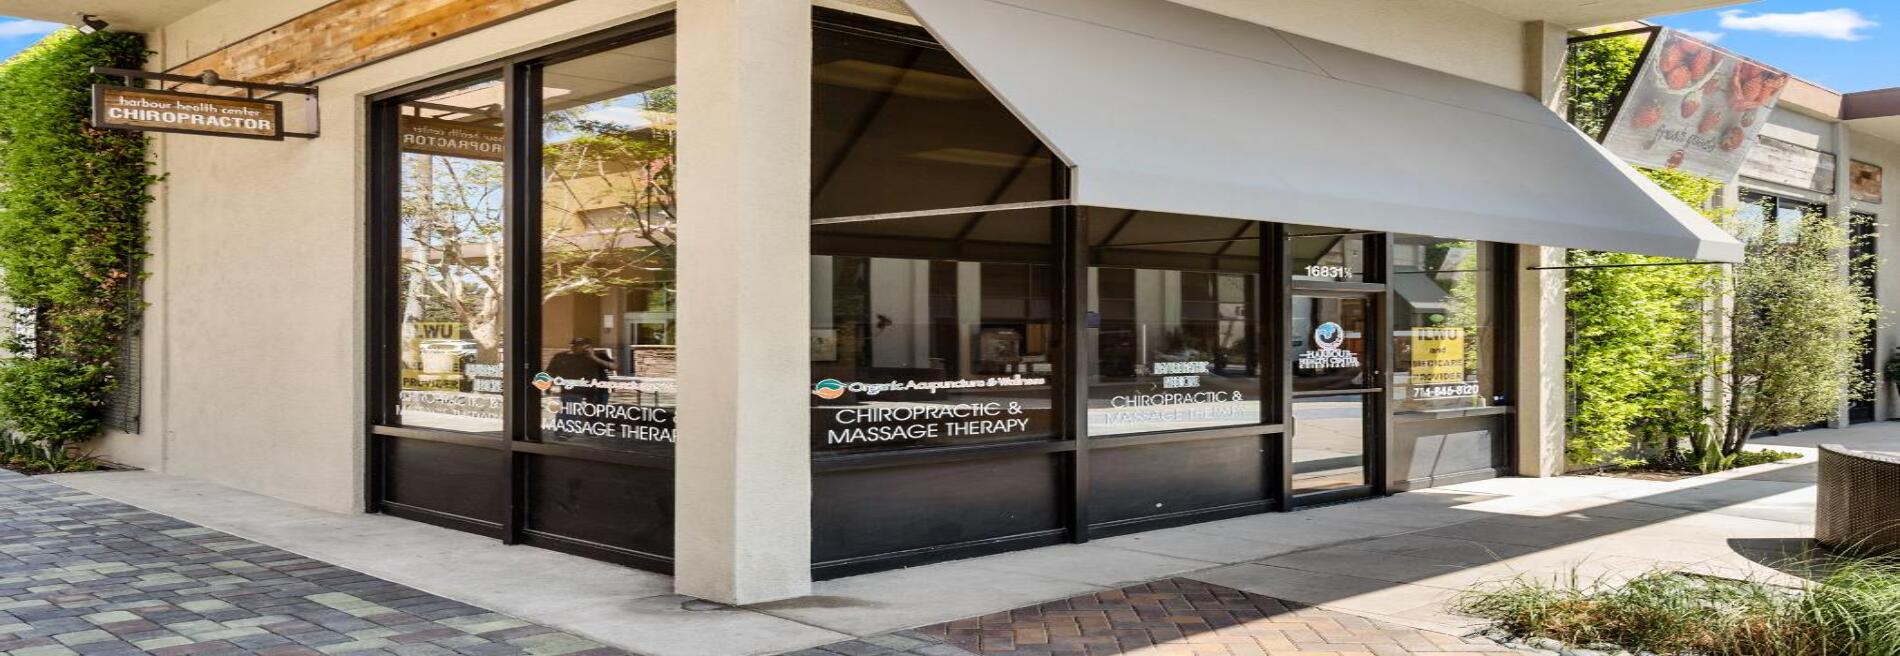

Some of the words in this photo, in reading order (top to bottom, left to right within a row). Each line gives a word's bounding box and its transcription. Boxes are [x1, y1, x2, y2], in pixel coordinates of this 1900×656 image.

[118, 96, 171, 111] harbour
[176, 101, 218, 113] health
[221, 107, 261, 118] center
[109, 107, 272, 130] CHIROPRACTOR
[1412, 360, 1464, 368] MEDICARE
[553, 376, 590, 390] Organic
[848, 380, 902, 396] Organic
[903, 378, 985, 394] Acupuncture
[1000, 374, 1045, 387] Wellness
[1413, 384, 1479, 398] 714-846-8120
[1111, 391, 1228, 409] CHIROPRACTIC
[1231, 390, 1243, 402] &
[547, 400, 667, 423] CHIROPRACTIC
[835, 402, 1001, 425] CHIROPRACTIC
[1007, 401, 1023, 415] &
[541, 418, 616, 438] MASSAGE
[620, 423, 678, 443] THERAP
[827, 423, 938, 445] MASSAGE
[945, 418, 1030, 437] THERAPY
